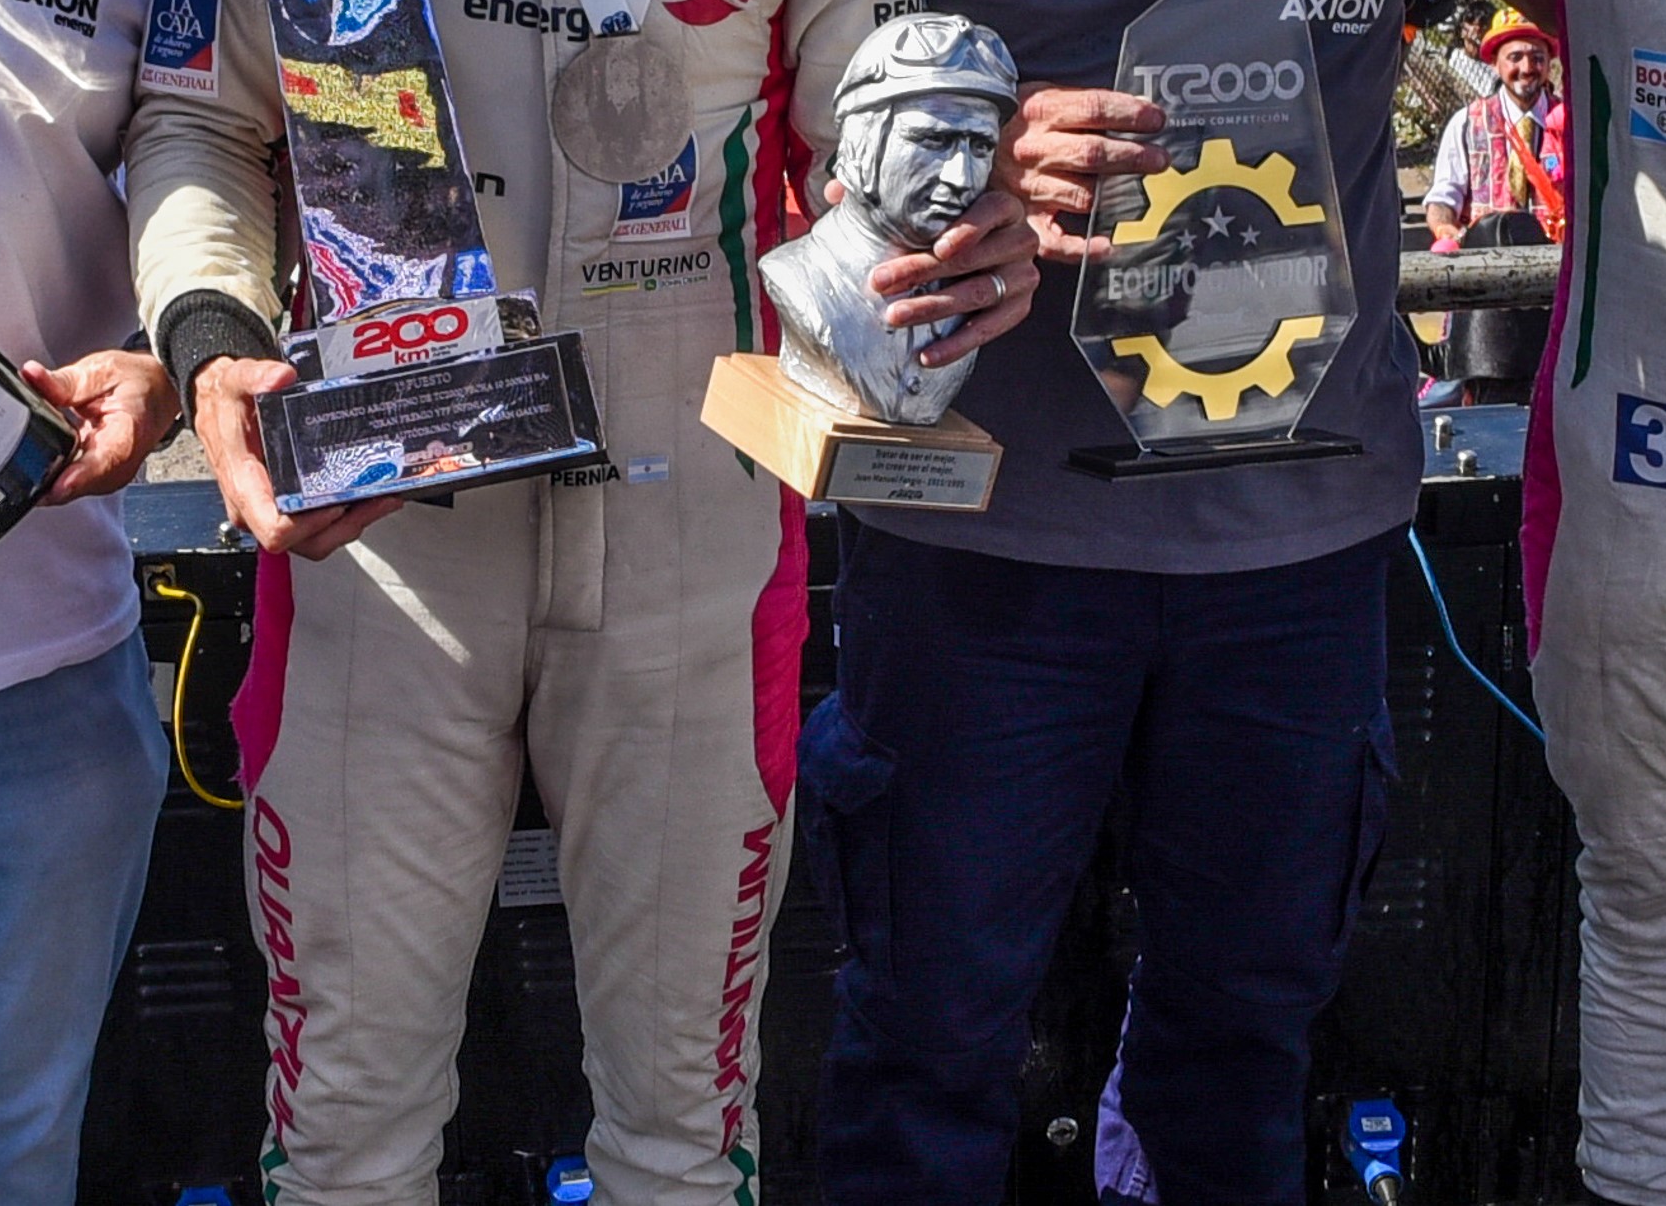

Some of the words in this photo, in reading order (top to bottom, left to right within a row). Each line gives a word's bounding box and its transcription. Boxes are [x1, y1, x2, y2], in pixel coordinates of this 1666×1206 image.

[54, 14, 96, 38] energy
[156, 11, 205, 39] CAJA
[154, 70, 215, 92] GENERALI
[630, 218, 688, 236] GENERALI
[582, 251, 712, 281] VENTURINO
[353, 306, 468, 359] 200
[395, 346, 429, 365] km
[550, 463, 621, 488] PERNIA
